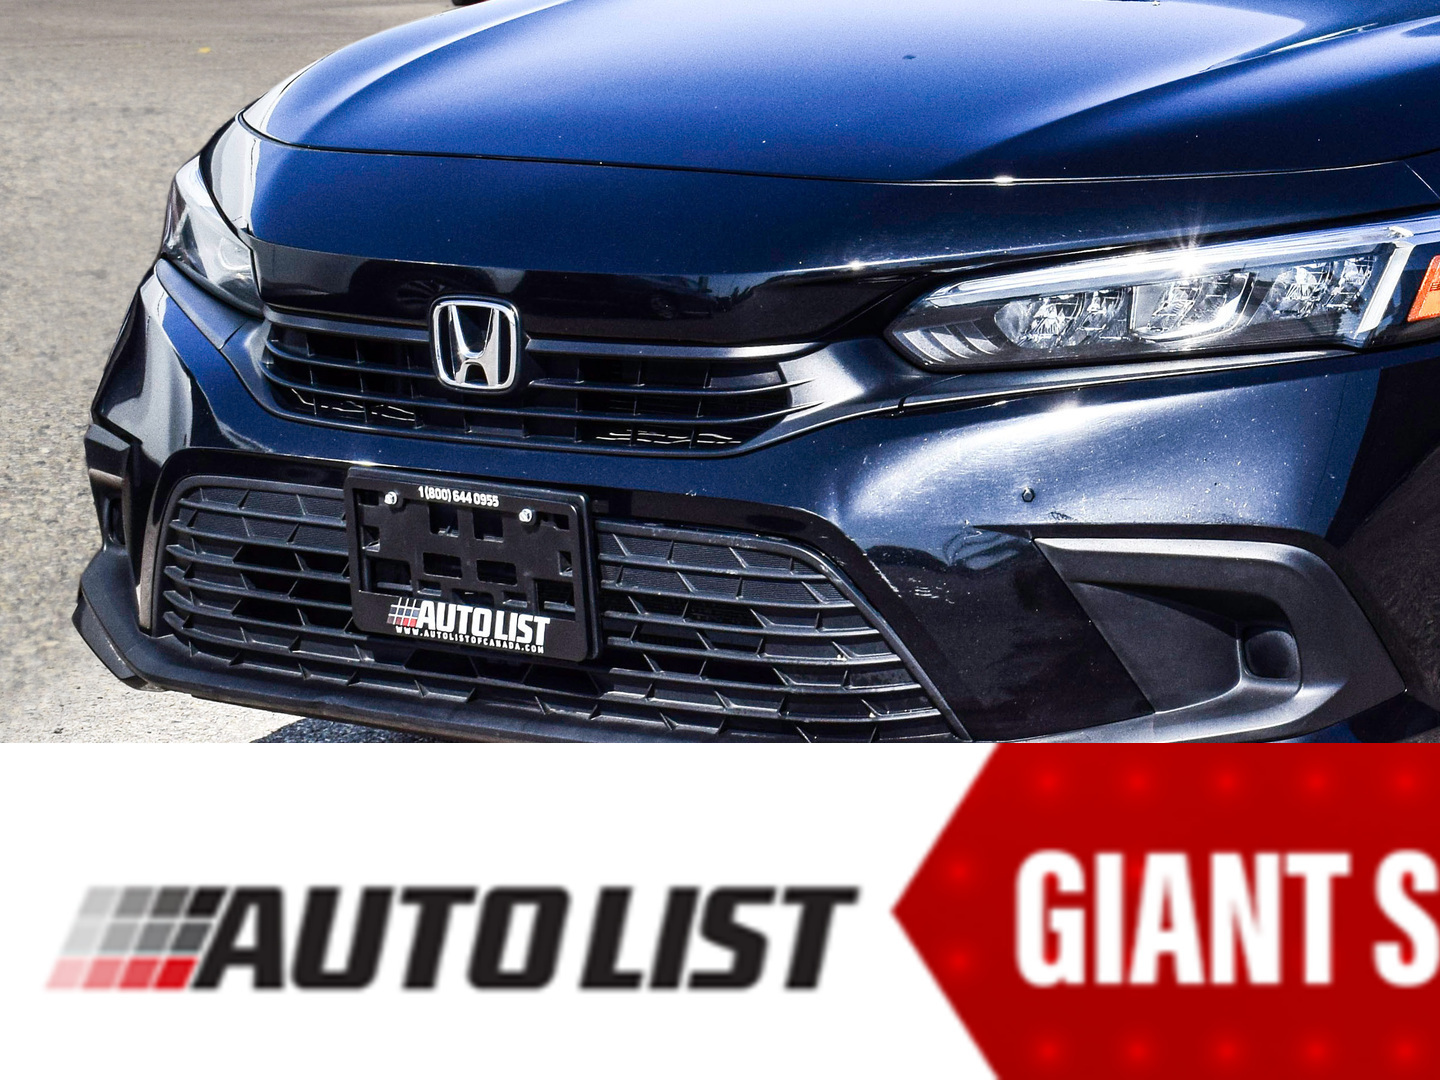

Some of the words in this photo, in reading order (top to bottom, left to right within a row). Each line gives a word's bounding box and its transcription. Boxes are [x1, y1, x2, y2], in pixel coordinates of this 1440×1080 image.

[418, 486, 424, 498] 1
[425, 486, 451, 503] (800)
[452, 490, 473, 504] 644
[473, 493, 499, 508] 0955
[416, 600, 492, 638] AUTO
[494, 610, 551, 646] LIST
[395, 625, 545, 654] WWW.AUTOLISTOFCANADA.COM
